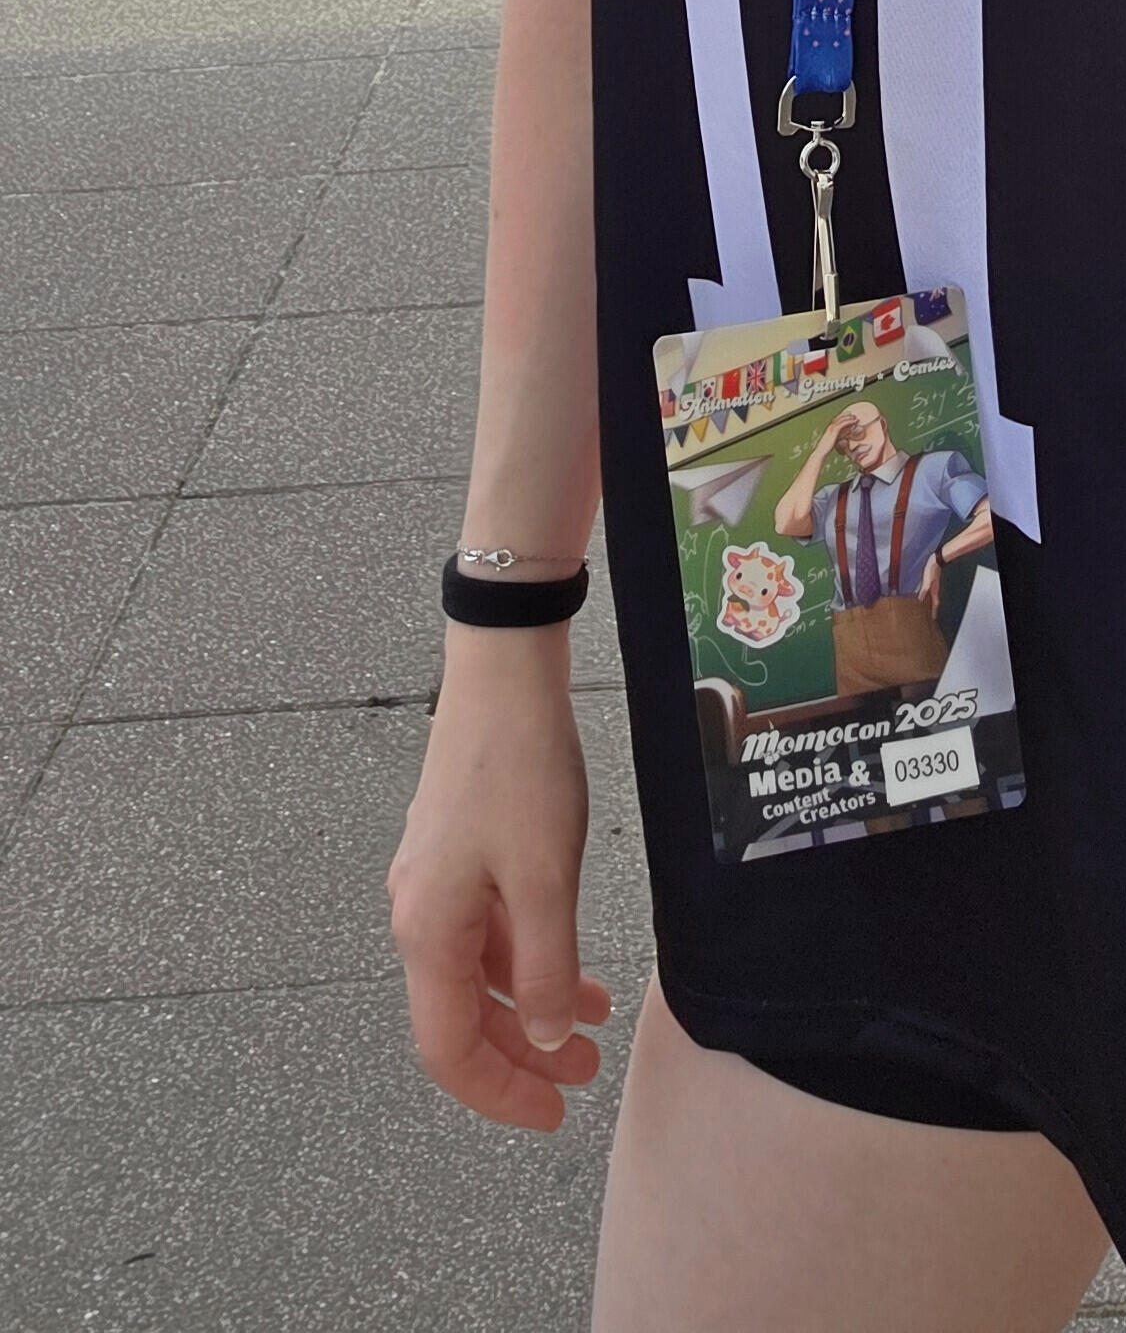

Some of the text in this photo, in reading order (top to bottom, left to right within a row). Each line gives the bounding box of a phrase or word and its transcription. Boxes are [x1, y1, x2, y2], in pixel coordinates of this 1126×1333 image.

[681, 355, 957, 420] Animation Gaming Comics
[895, 689, 979, 732] 2025
[849, 760, 871, 787] &
[895, 749, 960, 782] 03330
